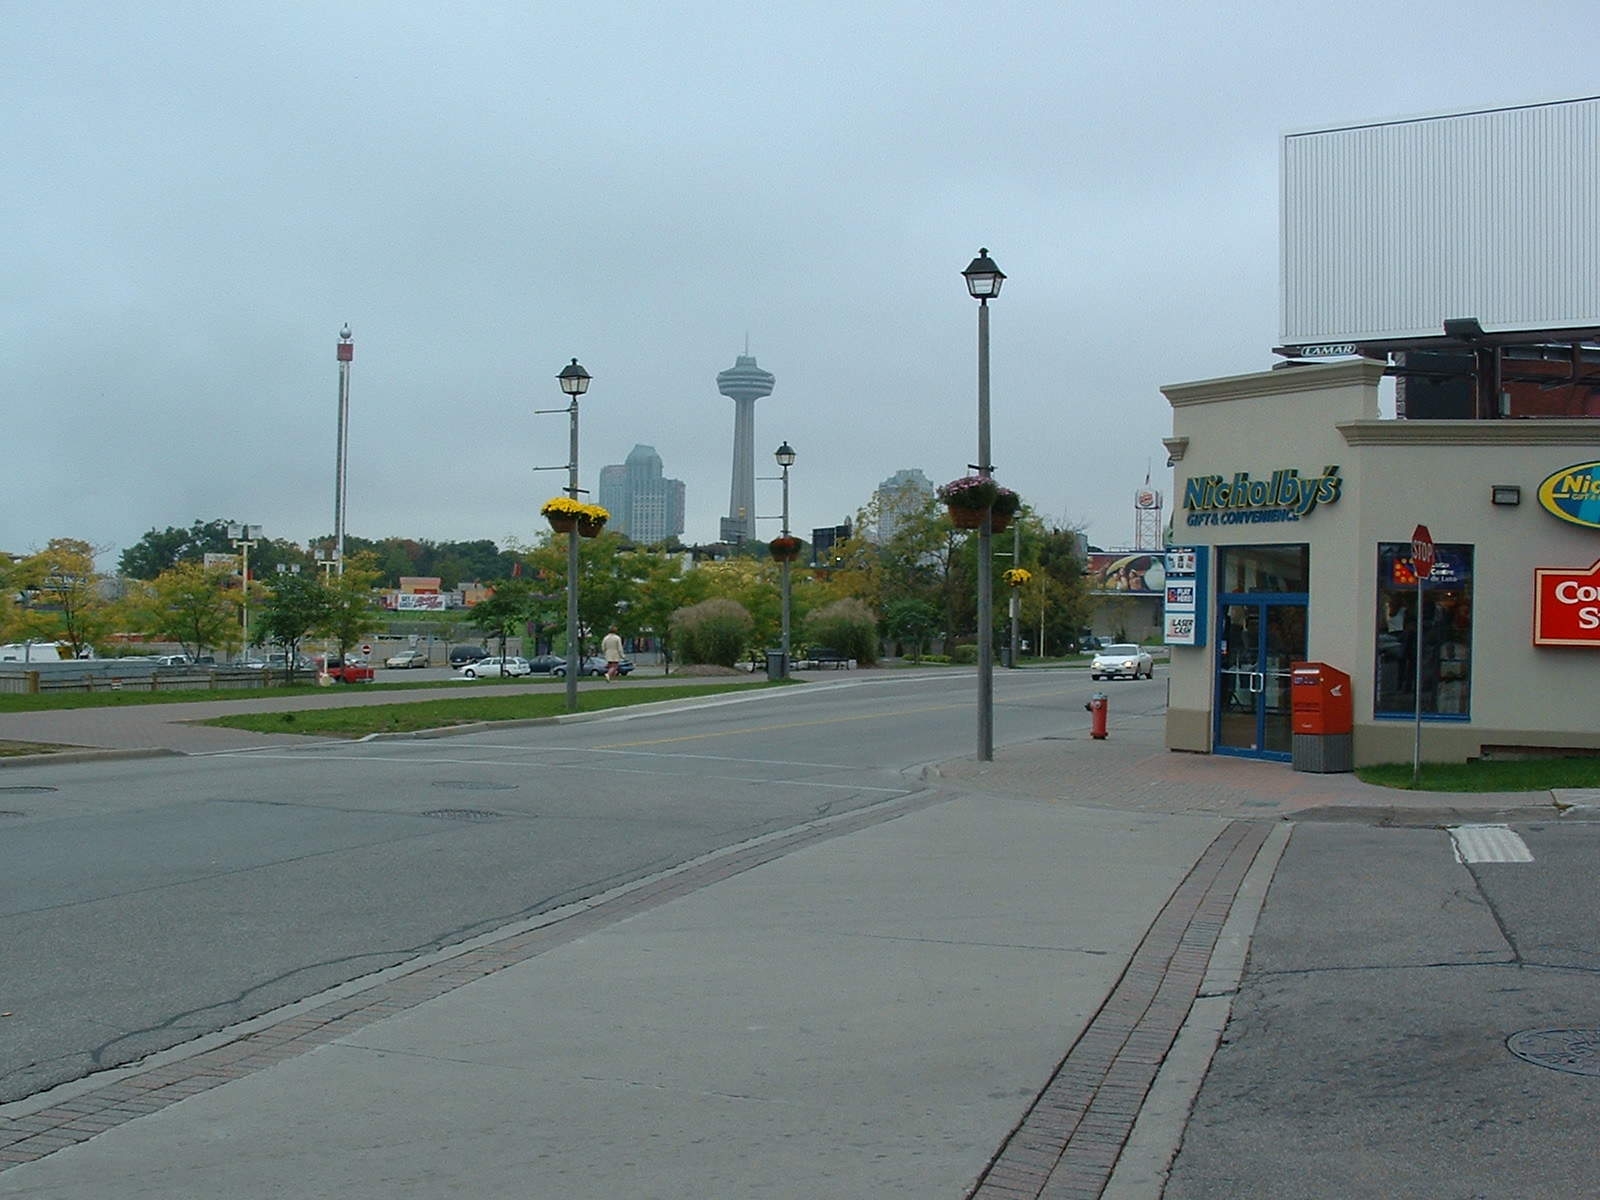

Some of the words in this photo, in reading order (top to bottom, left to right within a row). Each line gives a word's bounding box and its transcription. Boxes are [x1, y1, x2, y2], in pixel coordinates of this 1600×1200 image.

[1305, 344, 1353, 355] LAMAR
[1183, 465, 1342, 516] Nicholby's
[1187, 512, 1211, 526] GIFT
[1211, 512, 1219, 525] &
[1411, 540, 1433, 562] STOP
[1555, 581, 1600, 604] Co
[1173, 619, 1193, 627] LASER
[1578, 606, 1600, 629] S
